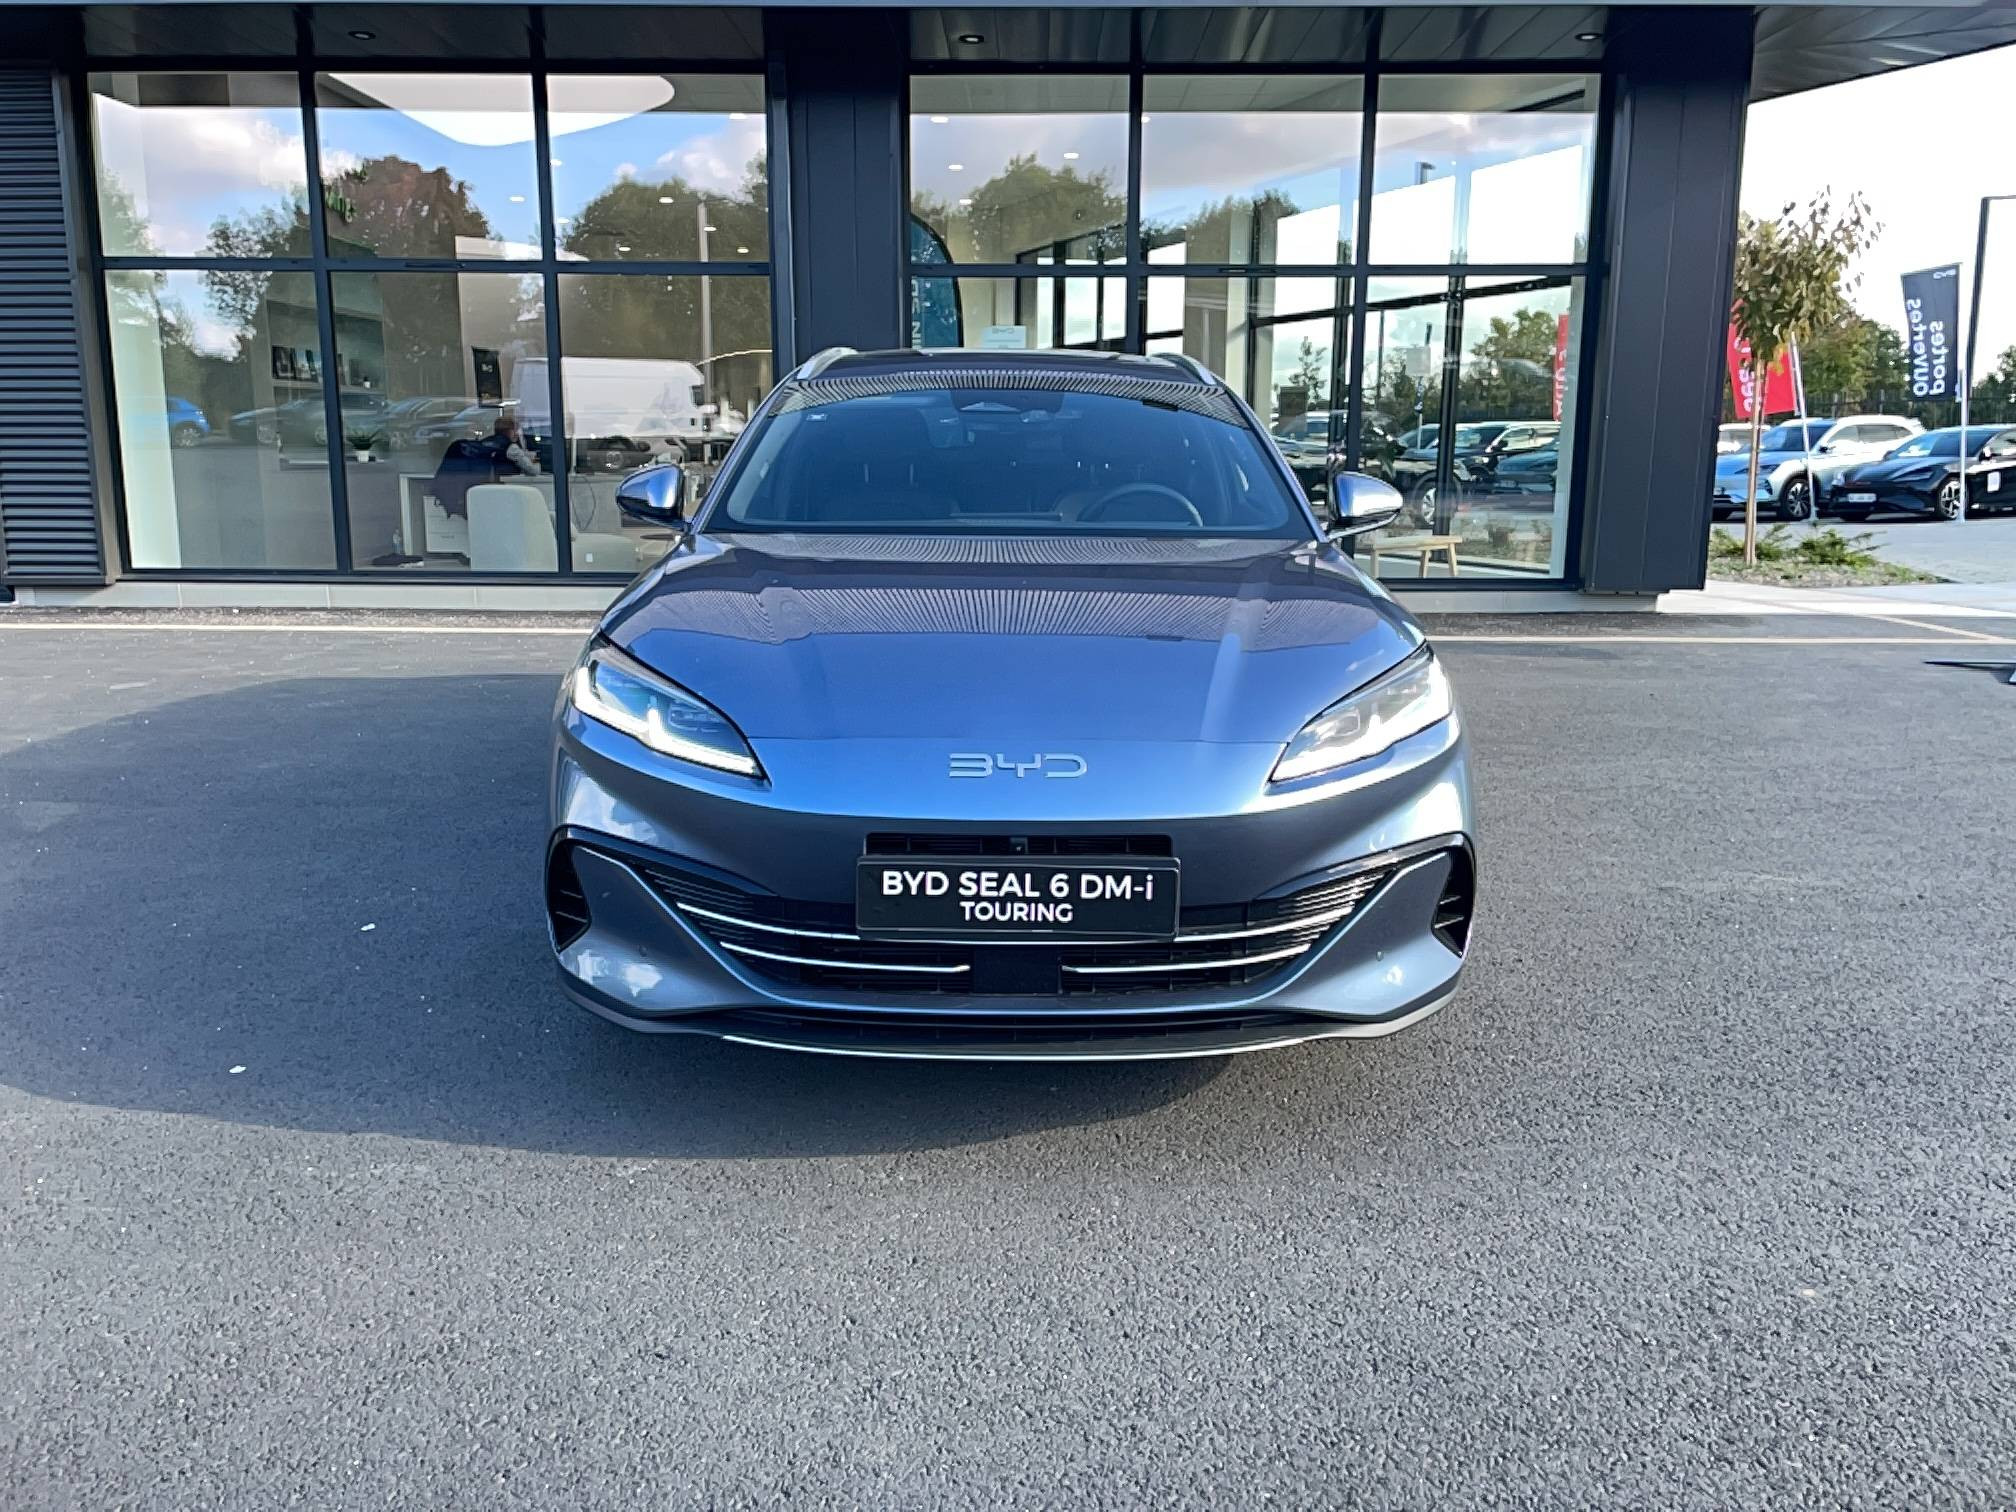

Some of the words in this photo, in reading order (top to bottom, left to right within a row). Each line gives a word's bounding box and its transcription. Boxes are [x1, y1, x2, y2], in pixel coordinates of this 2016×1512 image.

[949, 753, 1088, 778] BYD
[882, 870, 950, 896] BYD
[958, 873, 1041, 897] SEAL
[1050, 874, 1070, 898] 6
[1080, 874, 1154, 900] DM-i
[959, 901, 1073, 922] TOURING
